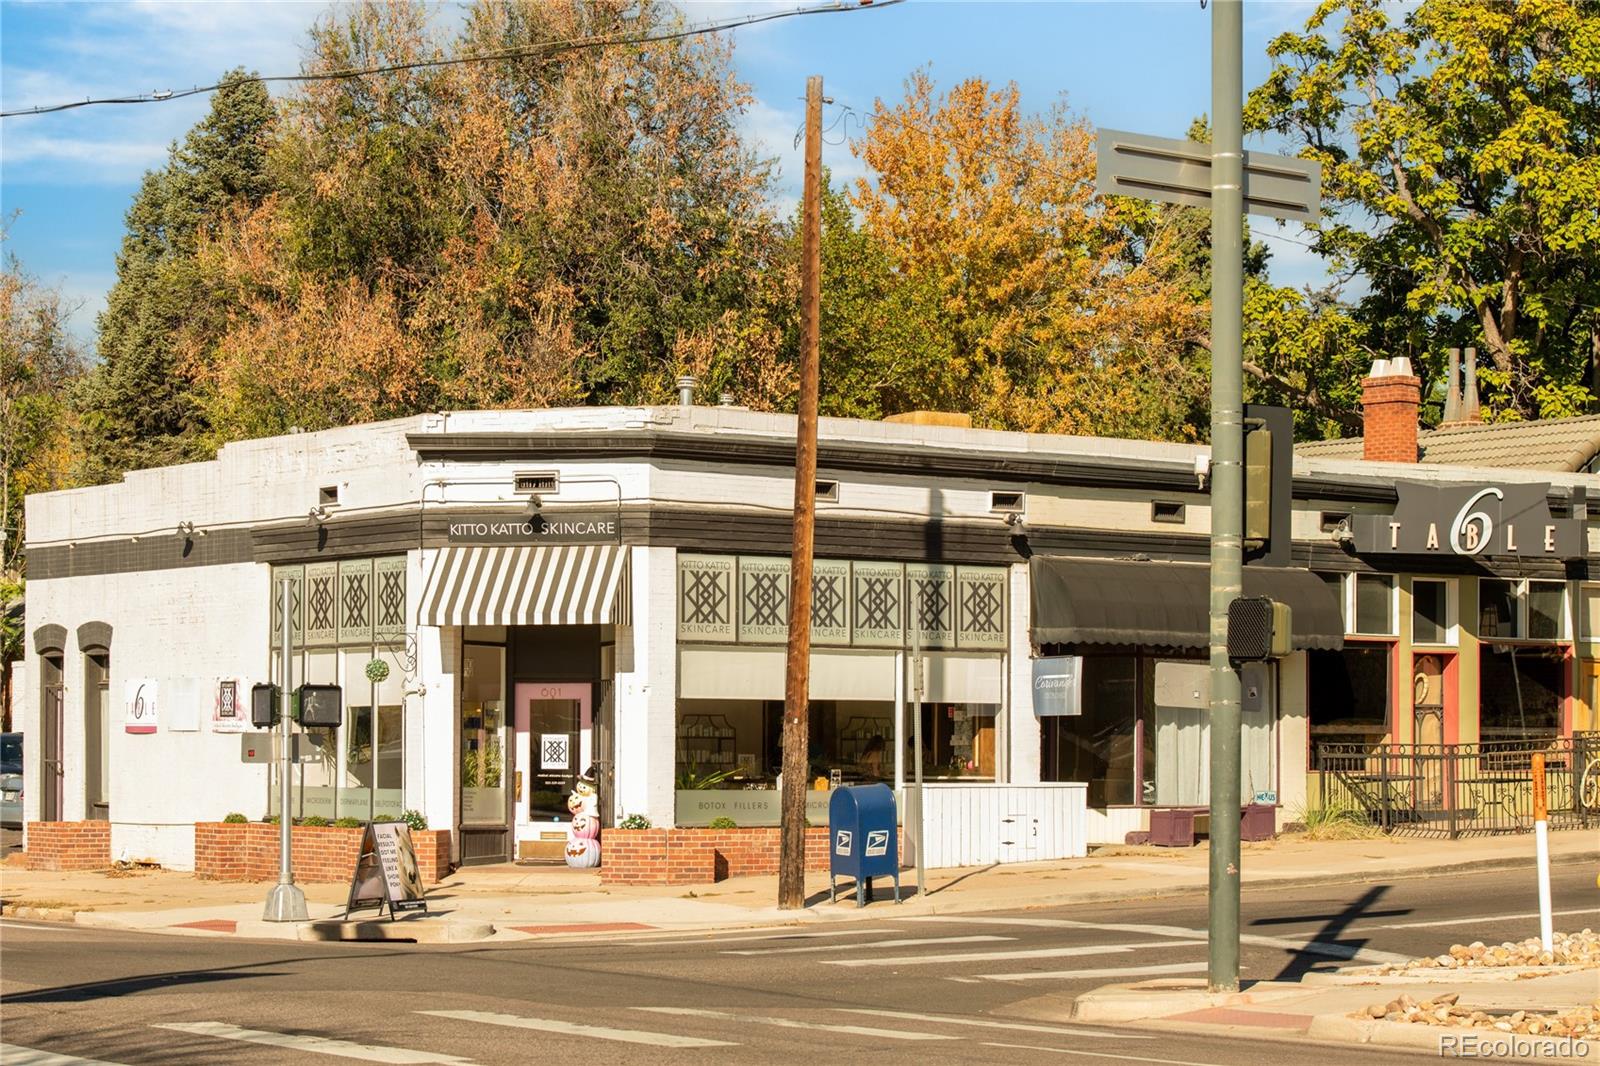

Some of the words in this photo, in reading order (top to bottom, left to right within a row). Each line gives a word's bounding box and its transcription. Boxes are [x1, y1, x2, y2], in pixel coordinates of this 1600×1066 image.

[1450, 487, 1504, 554] 6
[449, 523, 488, 536] KITTO
[490, 522, 534, 535] KATTO
[541, 521, 615, 535] SKINCARE
[1389, 522, 1556, 551] TABLE
[680, 560, 704, 569] KITTO
[704, 561, 731, 570] KATTO
[741, 563, 765, 572] KITTO
[765, 563, 790, 573] KATTO
[822, 566, 847, 575] KATTO
[855, 568, 877, 577] KITTO
[877, 568, 901, 578] KATTO
[907, 569, 929, 579] KITTO
[929, 570, 953, 580] KATTO
[959, 572, 982, 581] KITTO
[981, 572, 1004, 582] KATTO
[341, 628, 370, 638] SKINCARE
[680, 623, 731, 634] SKINCARE
[741, 626, 789, 636] SKINCARE
[811, 628, 847, 638] INCARE
[307, 629, 335, 640] SKINCARE
[855, 630, 901, 640] SKINCARE
[906, 630, 953, 641] SINCARE
[959, 632, 1005, 643] SKINCARE
[698, 801, 726, 810] BOTOX
[734, 801, 769, 810] FILLERS
